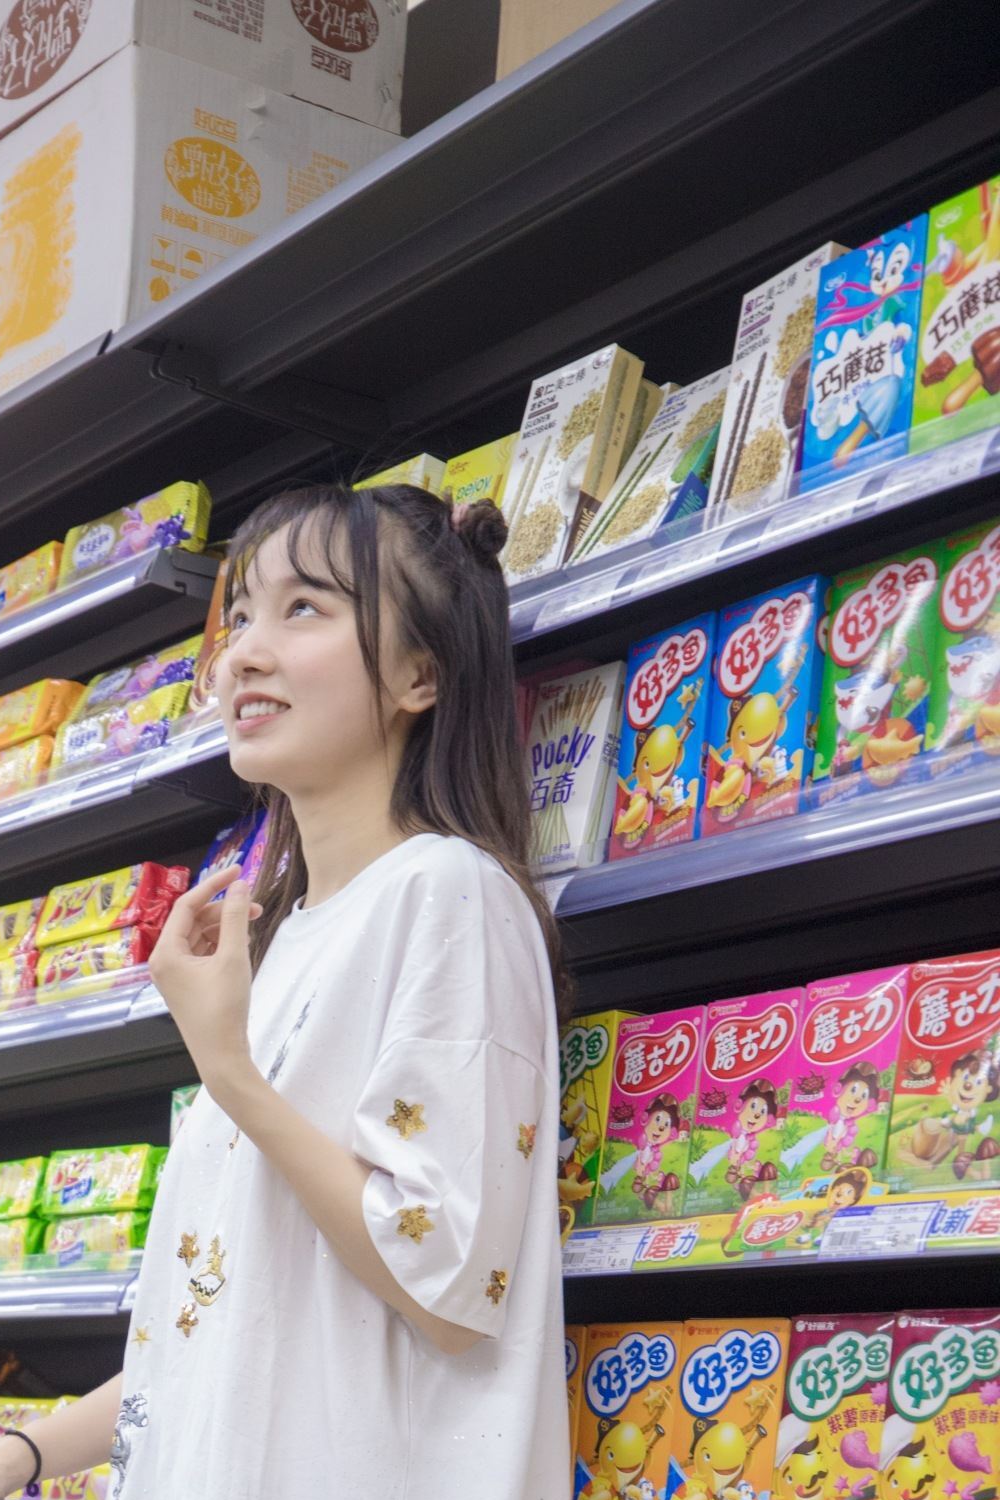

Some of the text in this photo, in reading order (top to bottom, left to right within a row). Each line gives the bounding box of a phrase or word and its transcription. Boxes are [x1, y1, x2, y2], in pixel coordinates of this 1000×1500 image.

[929, 269, 1000, 350] 巧蘑菇
[817, 341, 889, 404] 巧蘑菇
[726, 597, 807, 685] 好多鱼
[838, 563, 929, 654] 好多鱼
[633, 634, 702, 718] 好多鱼
[530, 772, 575, 812] 百奇
[811, 992, 893, 1054] 蘑古力
[916, 973, 1000, 1037] 蘑古力
[621, 1029, 691, 1086] 蘑古力
[712, 1012, 788, 1071] 蘑古力
[752, 1212, 801, 1241] 蘑古力
[593, 1339, 668, 1407] 好多鱼
[689, 1336, 773, 1406] 好多鱼
[796, 1337, 889, 1409] 好多鱼
[900, 1333, 999, 1409] 好多鱼
